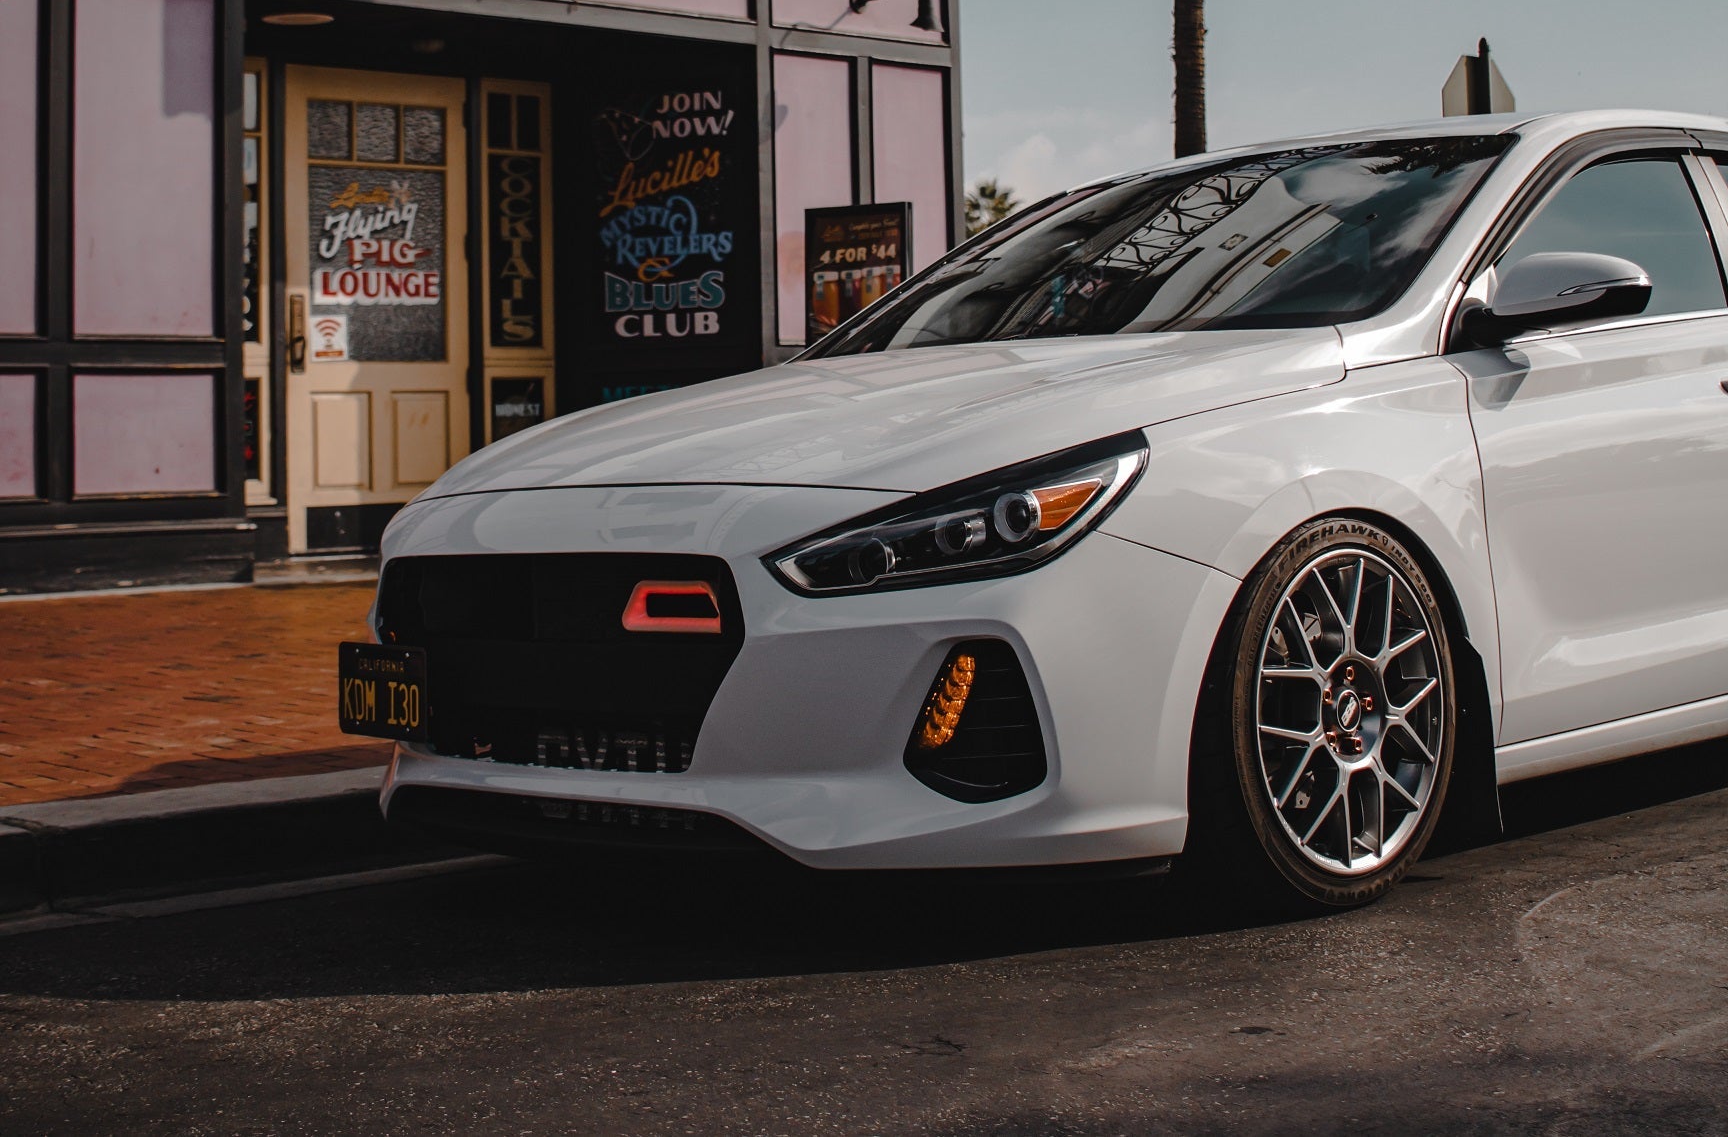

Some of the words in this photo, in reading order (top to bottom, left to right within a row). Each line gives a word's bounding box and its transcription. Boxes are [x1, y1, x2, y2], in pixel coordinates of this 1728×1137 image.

[656, 91, 722, 114] JOIN
[653, 110, 734, 139] NOW!
[598, 148, 720, 217] Lucille's
[318, 203, 418, 259] Flying
[616, 230, 733, 265] REVELERS
[349, 238, 428, 268] PIG
[499, 156, 535, 342] COCKTAILS
[819, 250, 831, 264] 4
[835, 247, 867, 263] FOR
[871, 243, 897, 259] $44
[319, 270, 440, 300] LOUNGE
[603, 270, 725, 312] BLUES
[614, 312, 720, 337] CLUB
[1278, 523, 1380, 573] FIREHAWK
[1391, 545, 1416, 572] INDY
[1415, 573, 1434, 605] 500
[344, 677, 376, 722] KDM
[387, 681, 419, 728] I30
